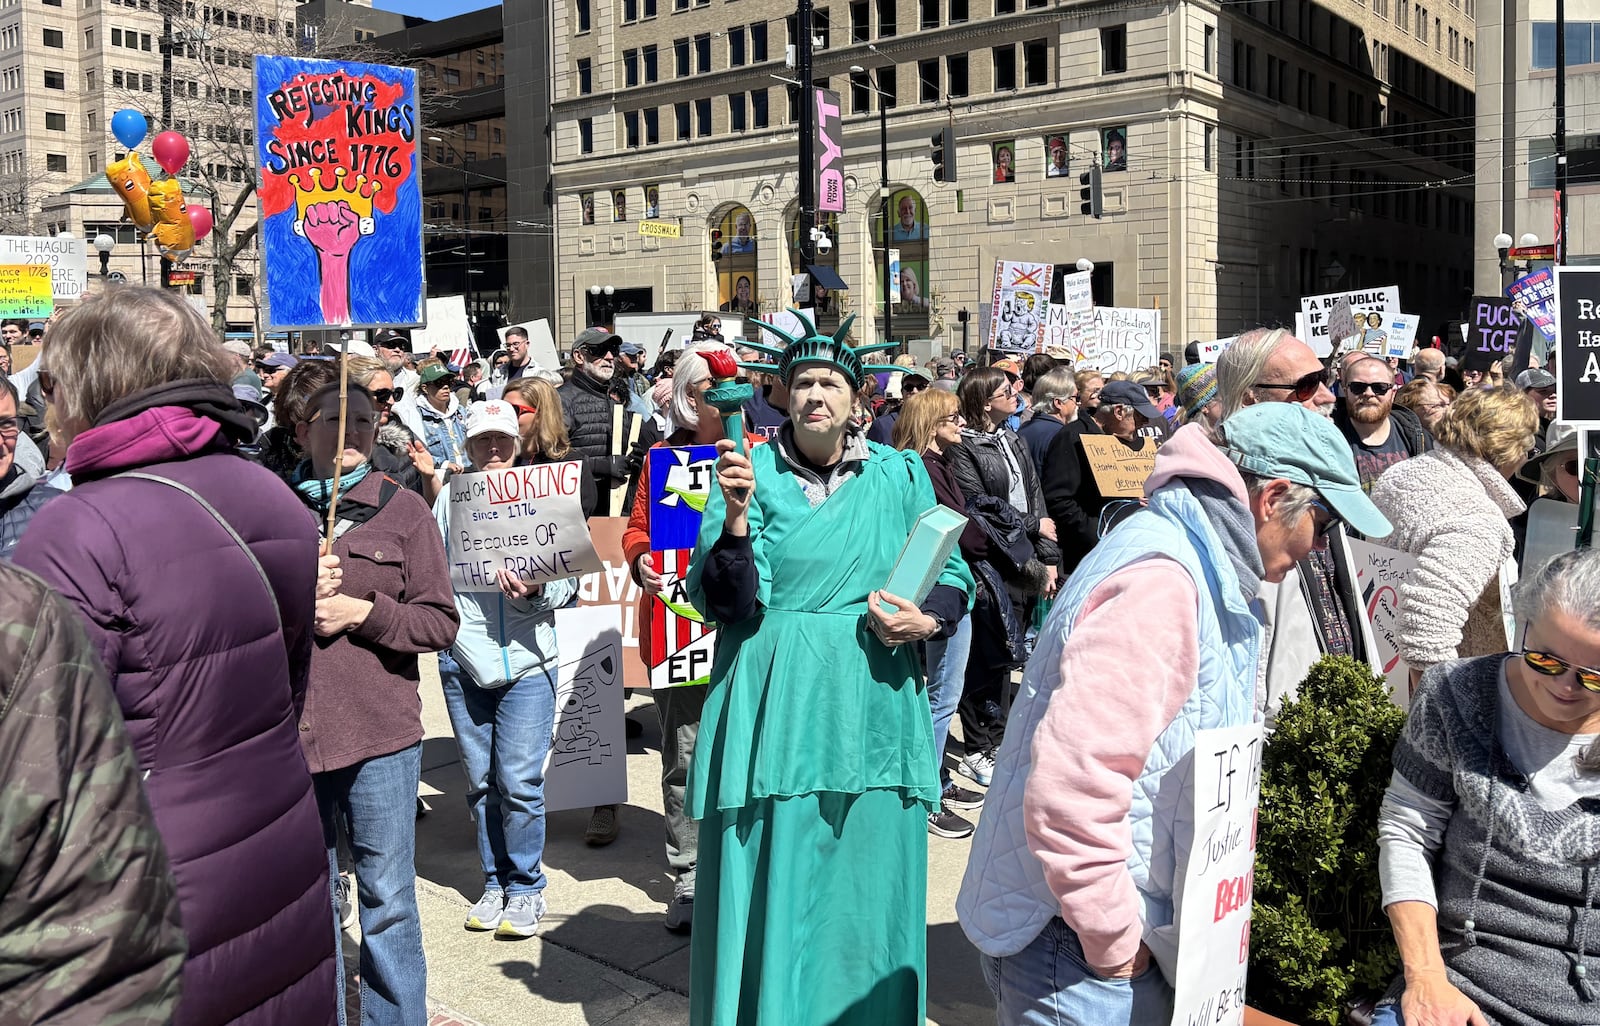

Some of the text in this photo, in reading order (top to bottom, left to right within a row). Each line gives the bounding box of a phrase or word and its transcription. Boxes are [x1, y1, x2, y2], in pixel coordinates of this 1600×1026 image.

[266, 75, 377, 128] REJECTING
[346, 104, 414, 142] KINGS
[266, 138, 401, 178] SINCE 1776
[640, 222, 678, 235] CROSSWALK
[7, 239, 76, 254] THE HAGUE
[28, 266, 48, 277] 1776
[52, 282, 83, 295] WILD!
[1509, 271, 1549, 295] HEY TRUMP
[1323, 292, 1389, 309] REUBLIC,
[1529, 291, 1540, 303] BE
[1035, 265, 1052, 354] BIGOT LIAR STUPID
[1049, 307, 1103, 326] MA
[1310, 313, 1322, 324] IF
[1476, 303, 1520, 326] FUCK
[1087, 444, 1108, 458] The
[1124, 464, 1141, 473] with
[473, 481, 486, 497] Of
[486, 471, 521, 502] NO
[523, 462, 579, 500] KING
[472, 502, 537, 522] since 1776
[460, 522, 558, 552] Because Of
[455, 550, 583, 587] THE BRAVE
[1368, 552, 1396, 569] Never
[1378, 568, 1412, 590] Forget
[553, 643, 618, 767] Protect
[1208, 744, 1240, 813] If
